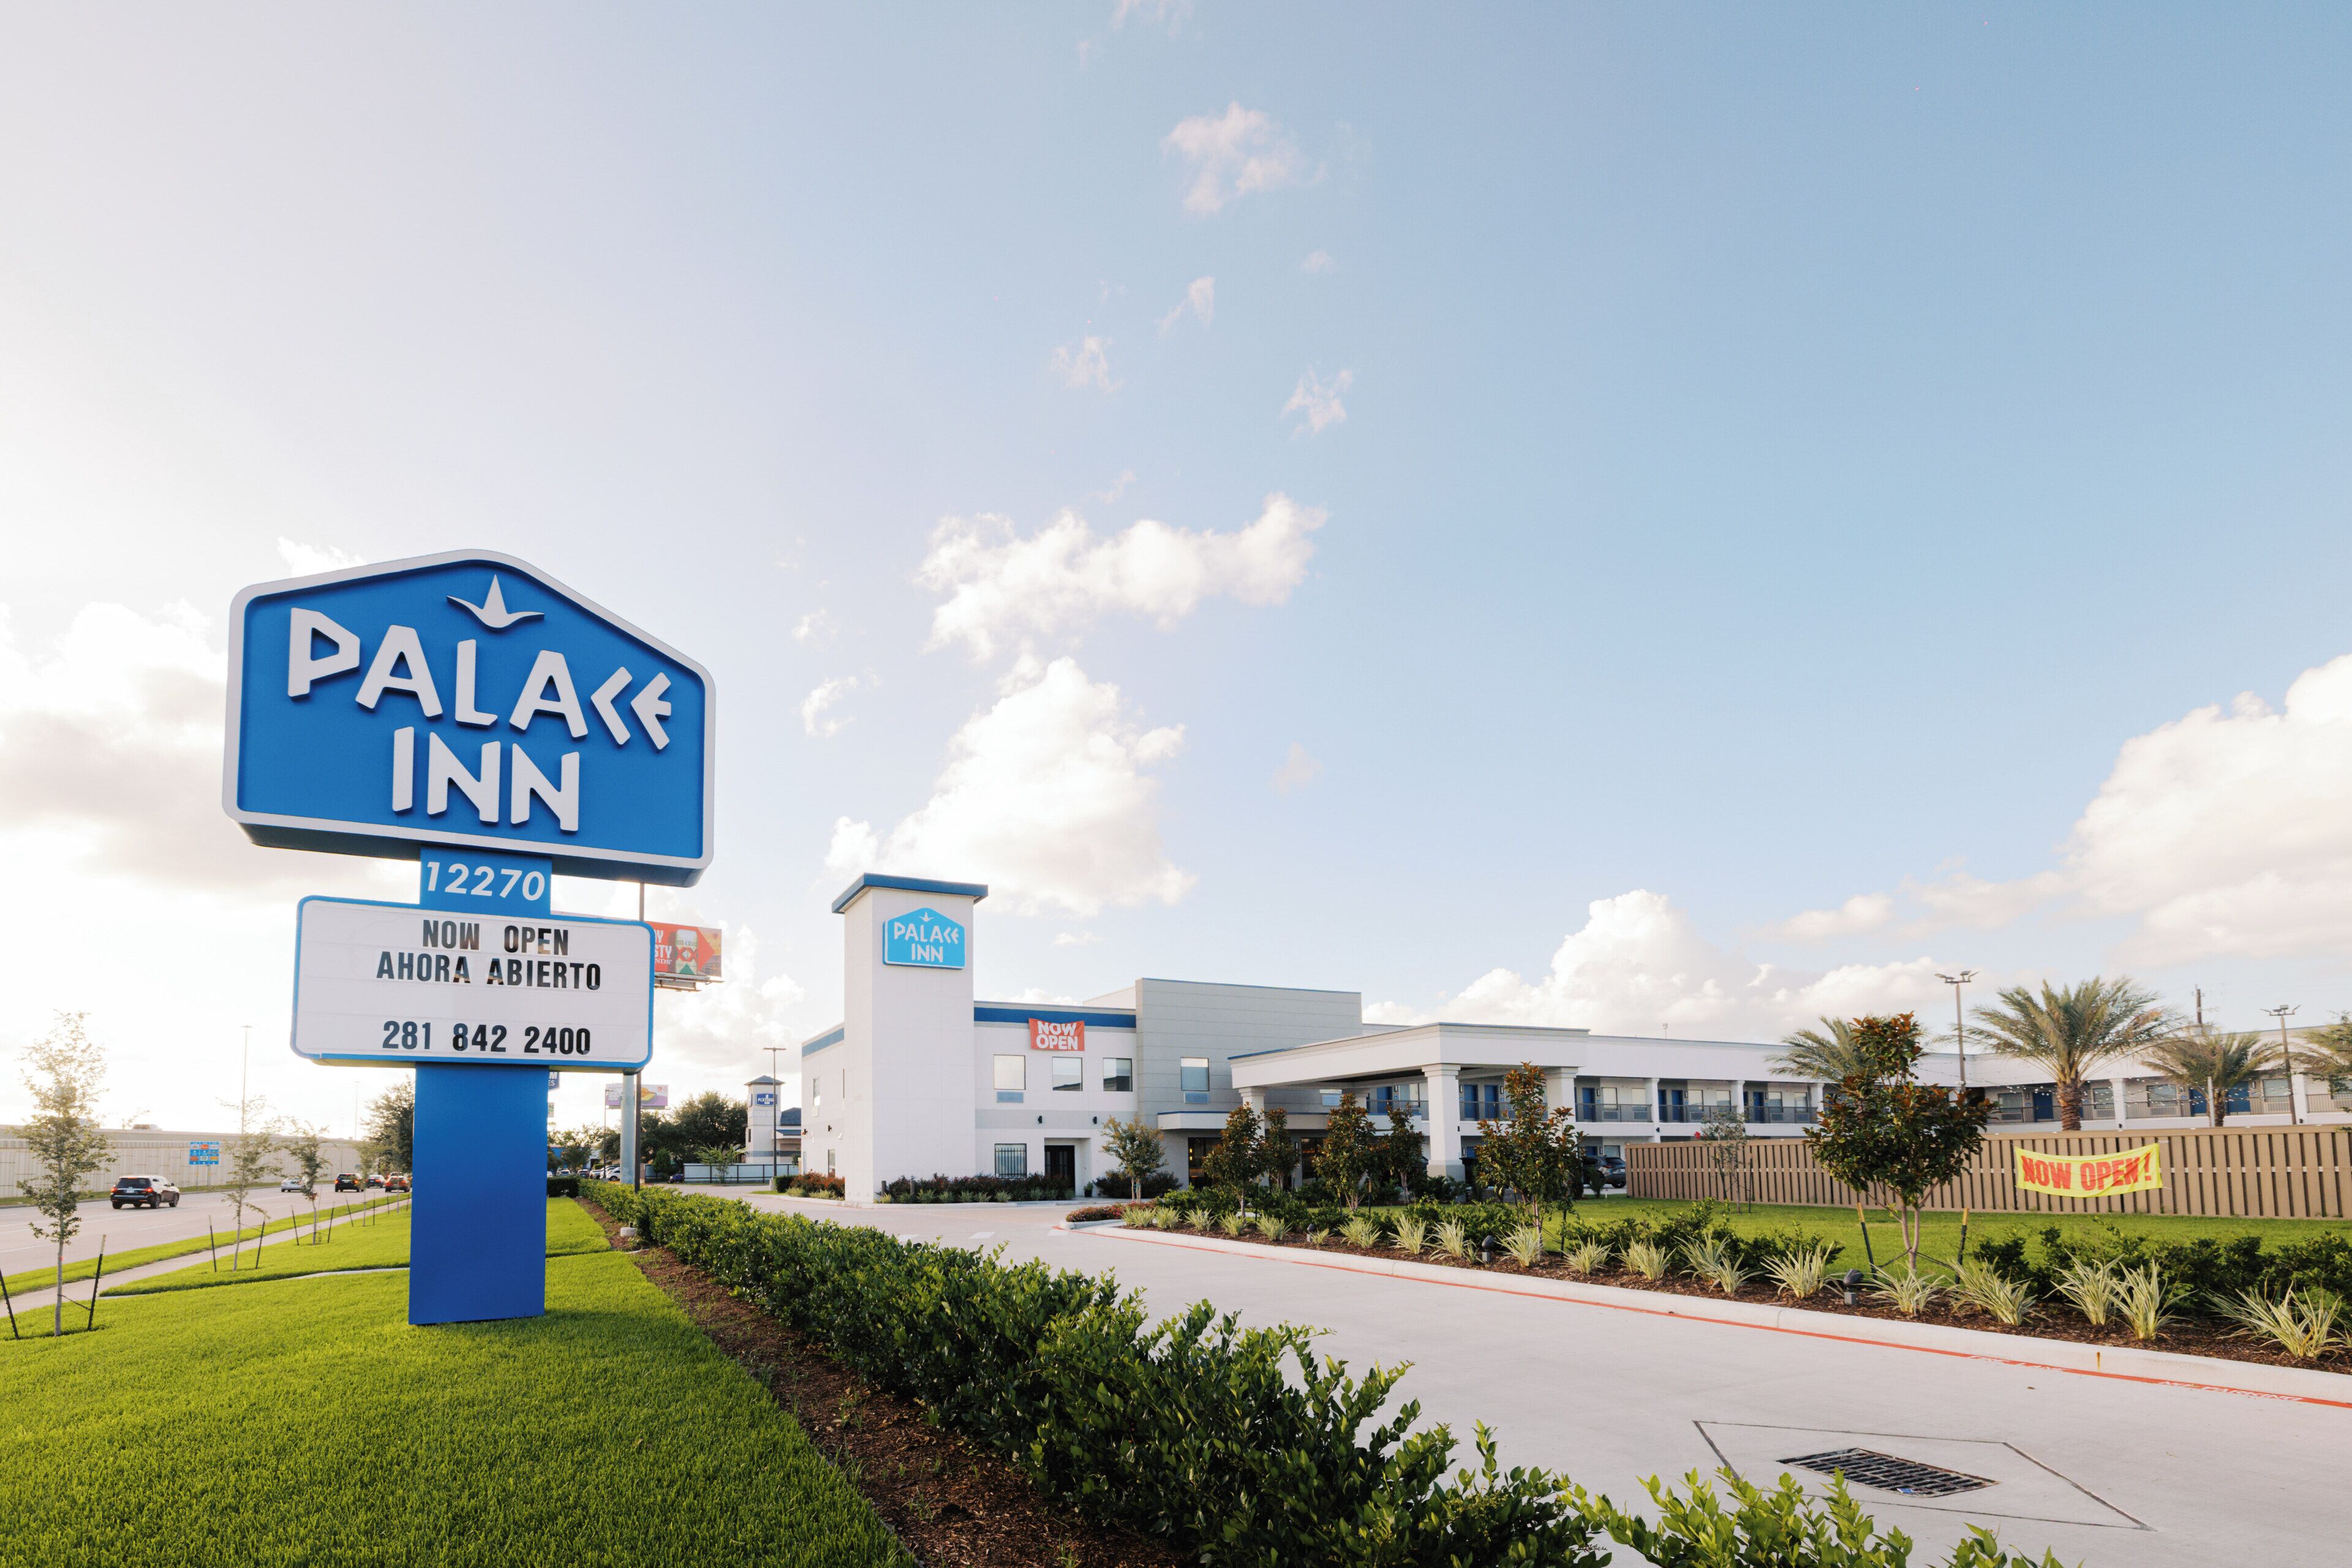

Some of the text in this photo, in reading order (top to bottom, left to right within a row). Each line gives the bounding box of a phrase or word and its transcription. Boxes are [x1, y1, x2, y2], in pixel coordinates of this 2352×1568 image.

[287, 607, 673, 751] PALACE
[392, 726, 580, 833] INN
[426, 861, 546, 901] 12270
[423, 920, 569, 956] NOW OPEN
[894, 921, 959, 944] PALACE
[377, 952, 601, 990] AHORA ABIERTO
[911, 943, 943, 963] INN
[382, 1020, 590, 1056] 281 842 2400
[1036, 1034, 1078, 1050] OPEN
[1038, 1020, 1076, 1037] NOW
[2021, 1152, 2152, 1191] NOW OPEN!
